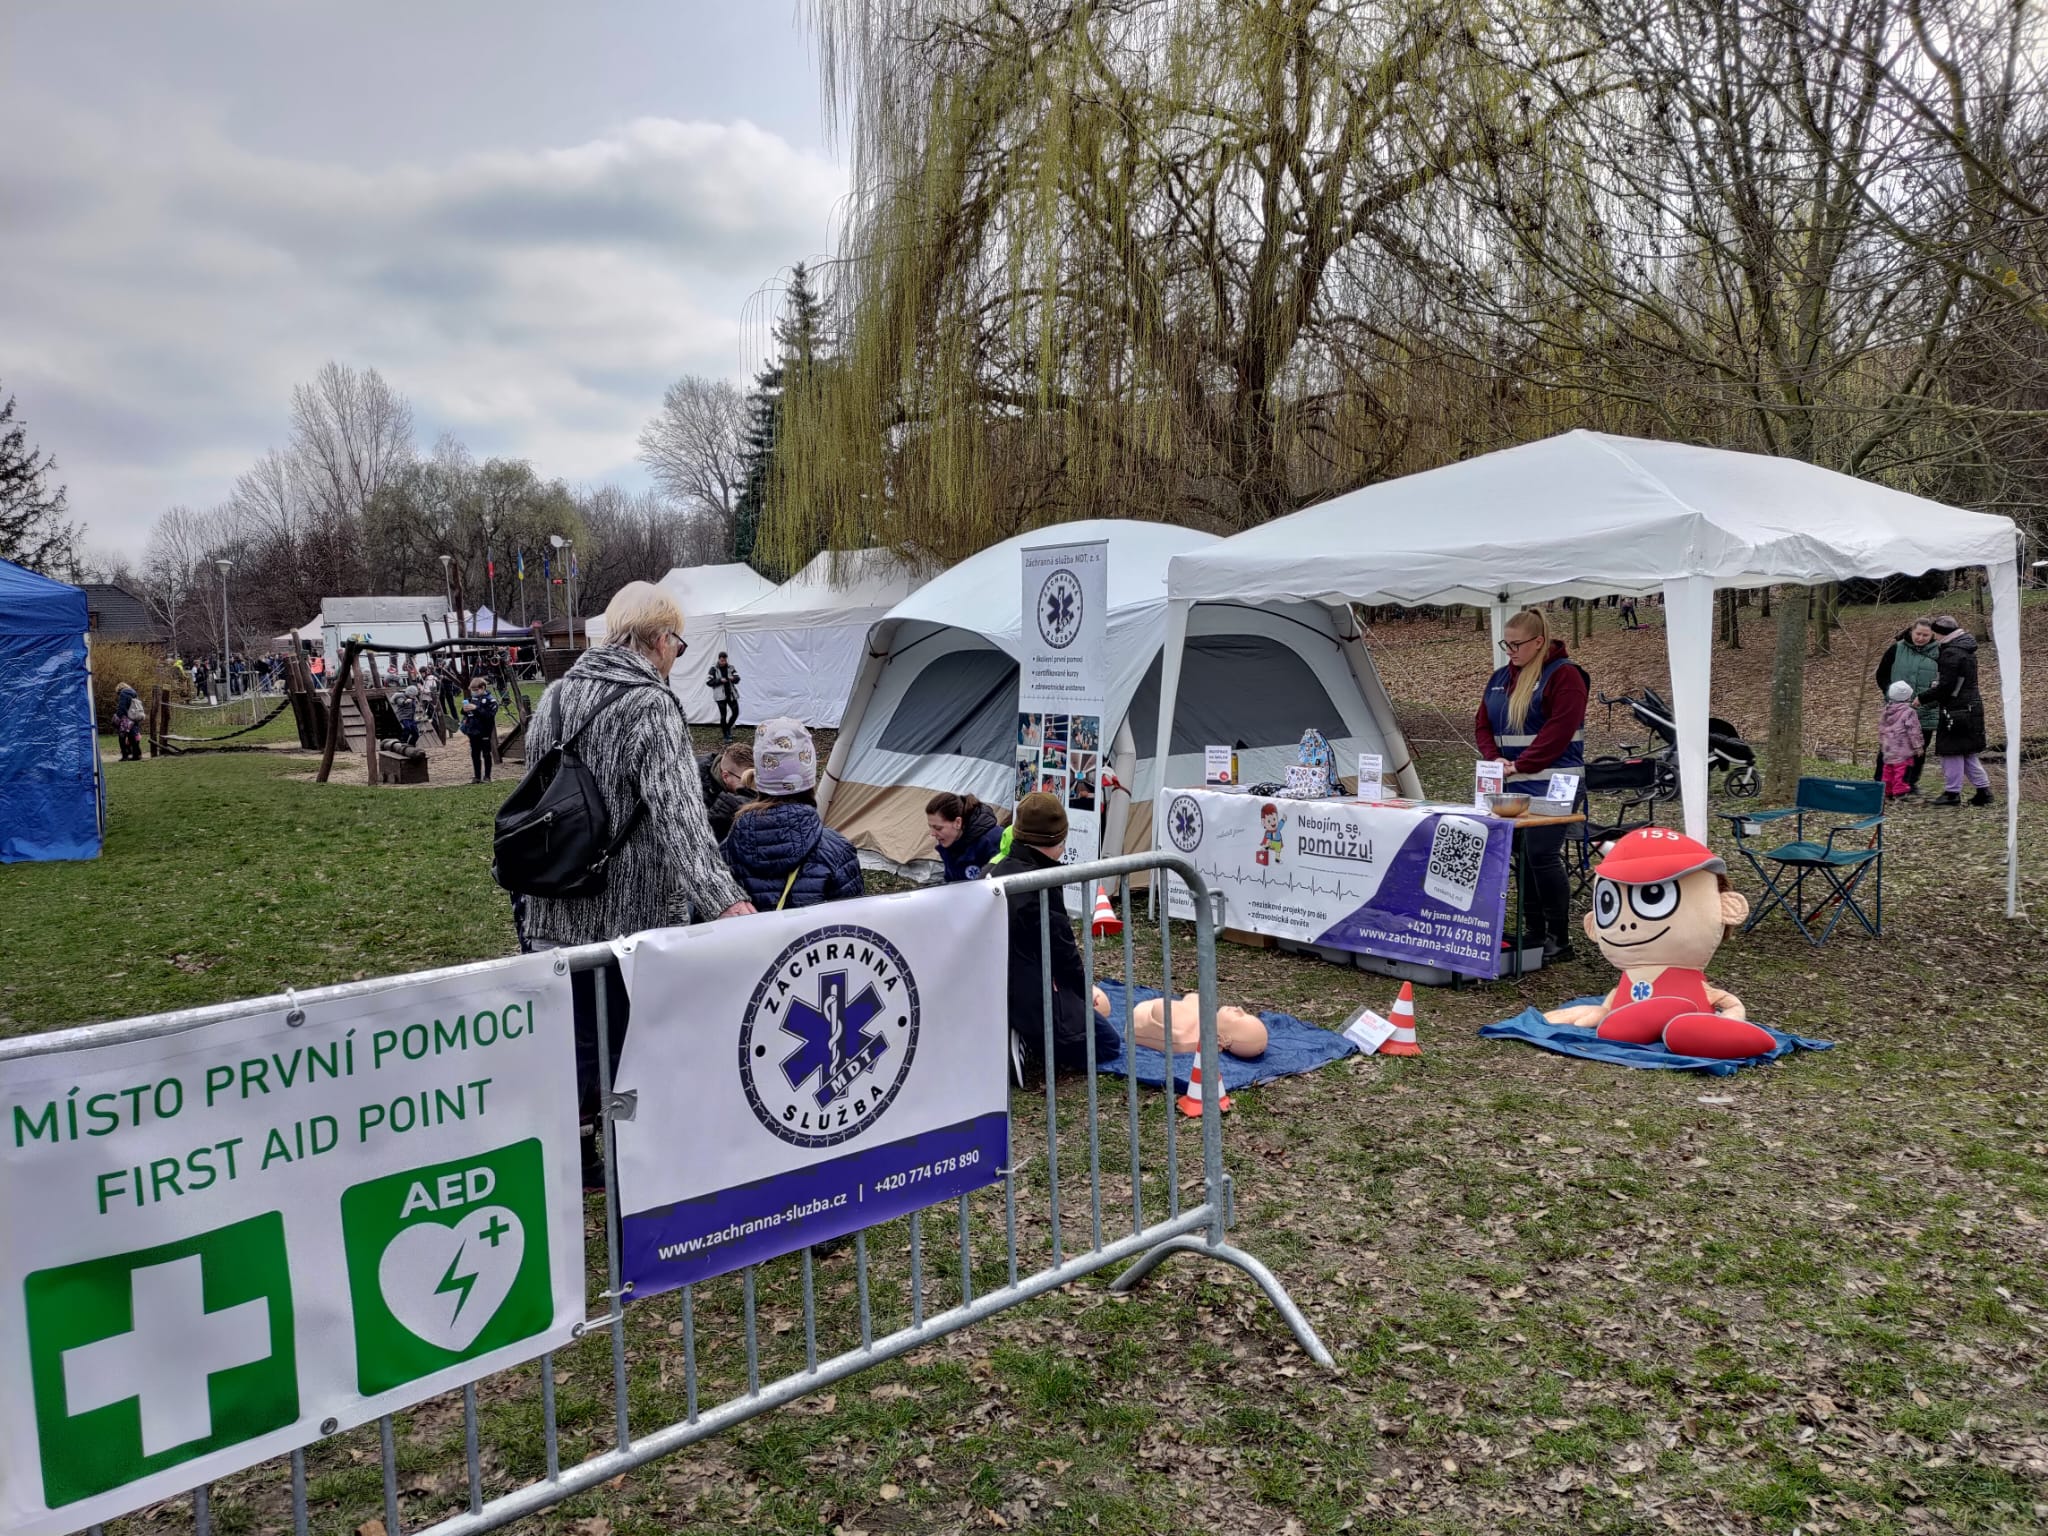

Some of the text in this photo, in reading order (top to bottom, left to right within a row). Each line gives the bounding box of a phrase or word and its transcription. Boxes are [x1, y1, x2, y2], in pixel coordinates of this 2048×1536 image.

[1298, 815, 1361, 836] Nebojím se,
[1298, 832, 1373, 860] pomůžu!
[1251, 900, 1282, 911] neziskové
[1282, 905, 1307, 918] projekty
[1251, 911, 1289, 925] zdravotnická
[1420, 908, 1433, 920] My
[1433, 910, 1452, 922] jsme
[1359, 926, 1492, 962] www.zachranna-sluzba.cz
[1407, 920, 1493, 947] +420 774 678 890
[764, 943, 901, 1015] ZÁCHRANNÁ
[13, 999, 535, 1148] MÍSTO PRVNÍ POMOCI
[830, 1049, 874, 1095] MDT
[782, 1084, 884, 1131] SLUŽBA
[97, 1077, 493, 1215] FIRST AID POINT
[400, 1166, 497, 1219] AED
[657, 1191, 848, 1261] www.zachranna-sluzba.cz
[874, 1172, 907, 1194] +420
[908, 1163, 932, 1185] 774
[933, 1156, 957, 1177] 678
[958, 1149, 980, 1169] 890
